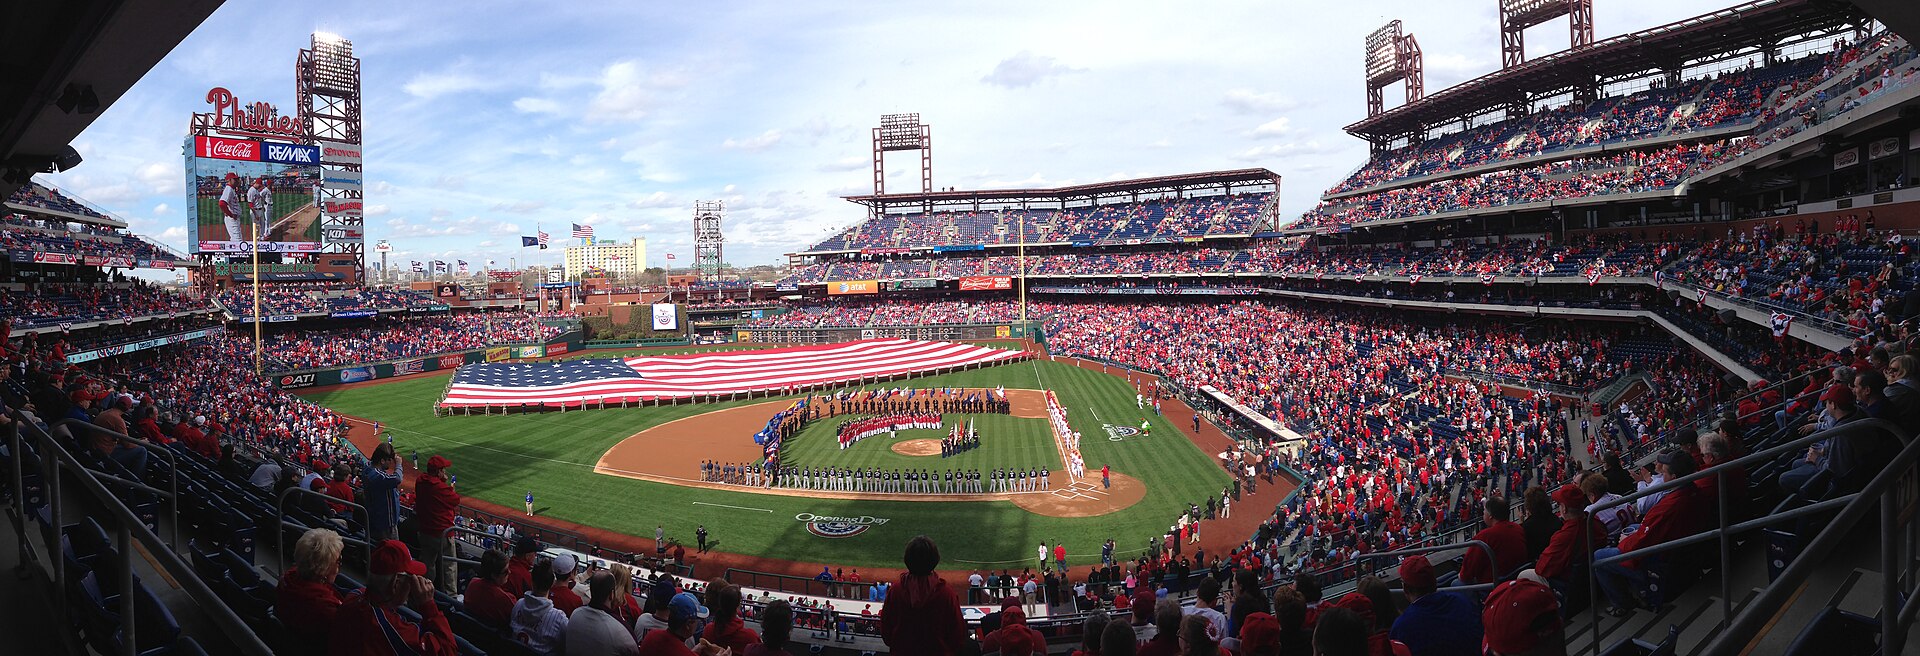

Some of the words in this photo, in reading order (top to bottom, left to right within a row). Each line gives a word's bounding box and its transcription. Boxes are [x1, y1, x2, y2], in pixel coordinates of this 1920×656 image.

[206, 87, 303, 135] Phillies
[213, 140, 253, 158] Coca-Cola
[268, 145, 311, 163] RE/MAX
[334, 149, 361, 158] TOYOTA
[231, 262, 270, 273] Citizns
[271, 263, 291, 273] Bank
[295, 263, 316, 273] Park
[850, 283, 866, 291] at&t
[523, 348, 538, 356] Gulf
[440, 355, 463, 367] xfinity
[292, 374, 315, 384] ATI
[795, 513, 858, 525] Opening
[857, 516, 890, 526] Day
